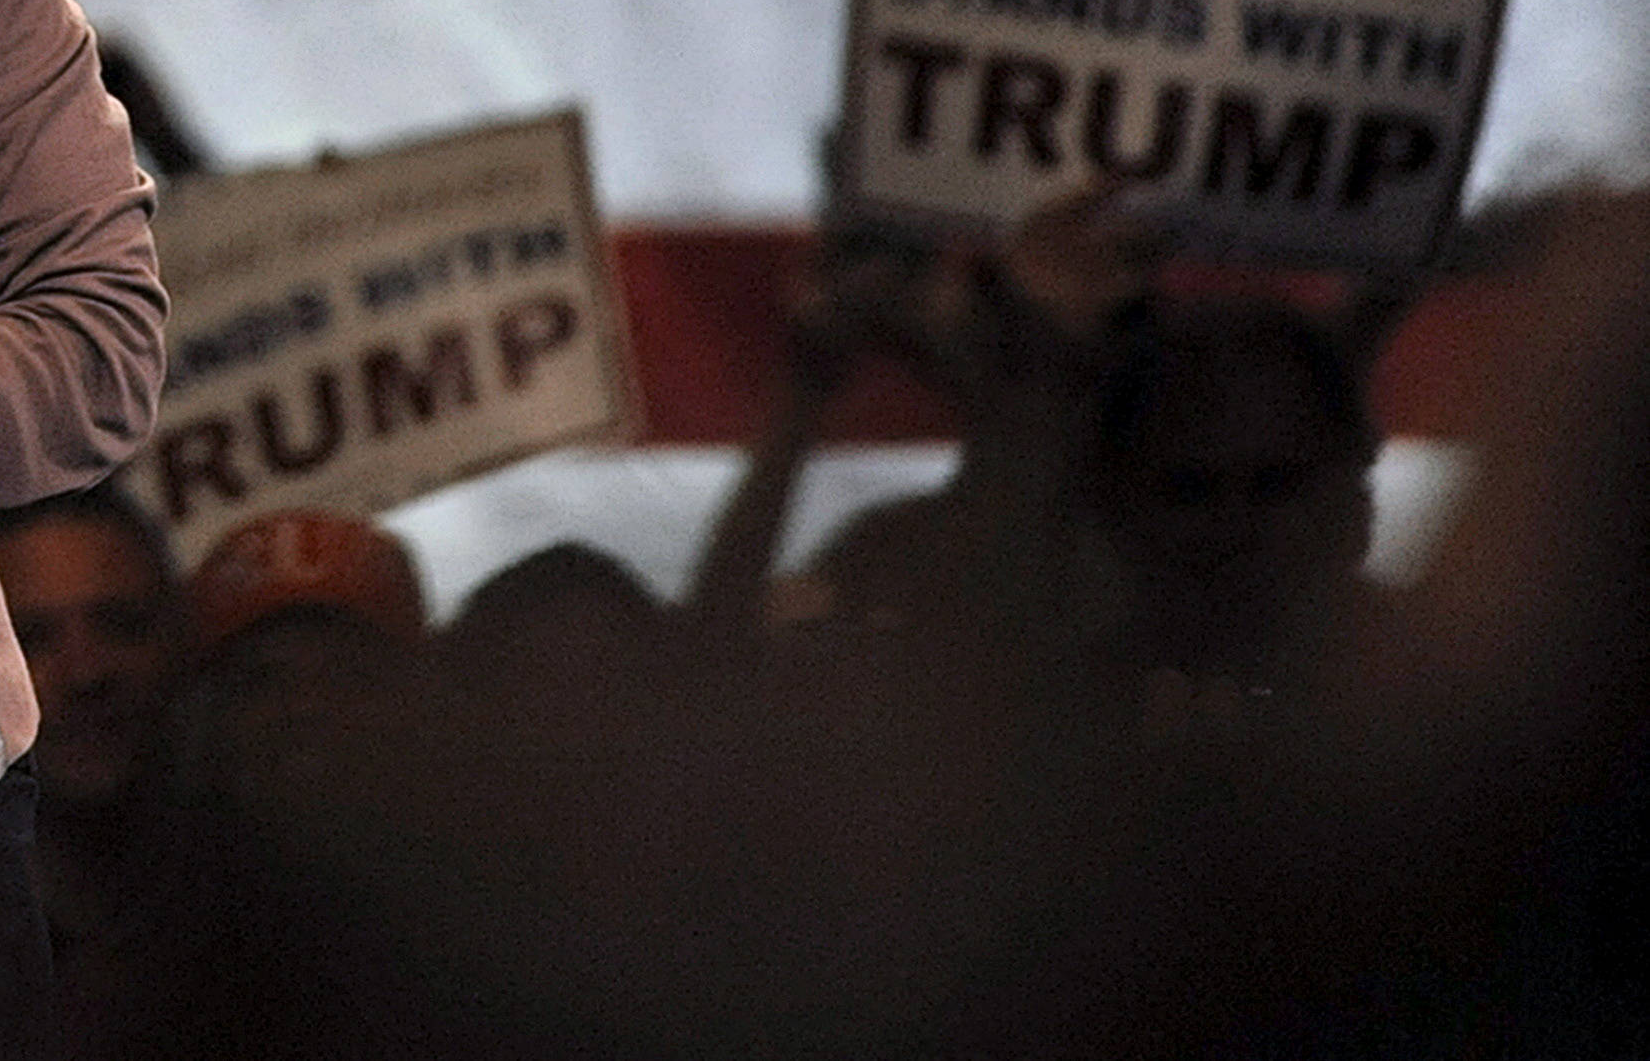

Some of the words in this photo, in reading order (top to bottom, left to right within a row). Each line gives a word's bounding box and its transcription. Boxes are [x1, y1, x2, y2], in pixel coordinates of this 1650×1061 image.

[880, 38, 1446, 207] TRUMP
[1240, 0, 1464, 87] WITH
[156, 291, 580, 523] RUMP
